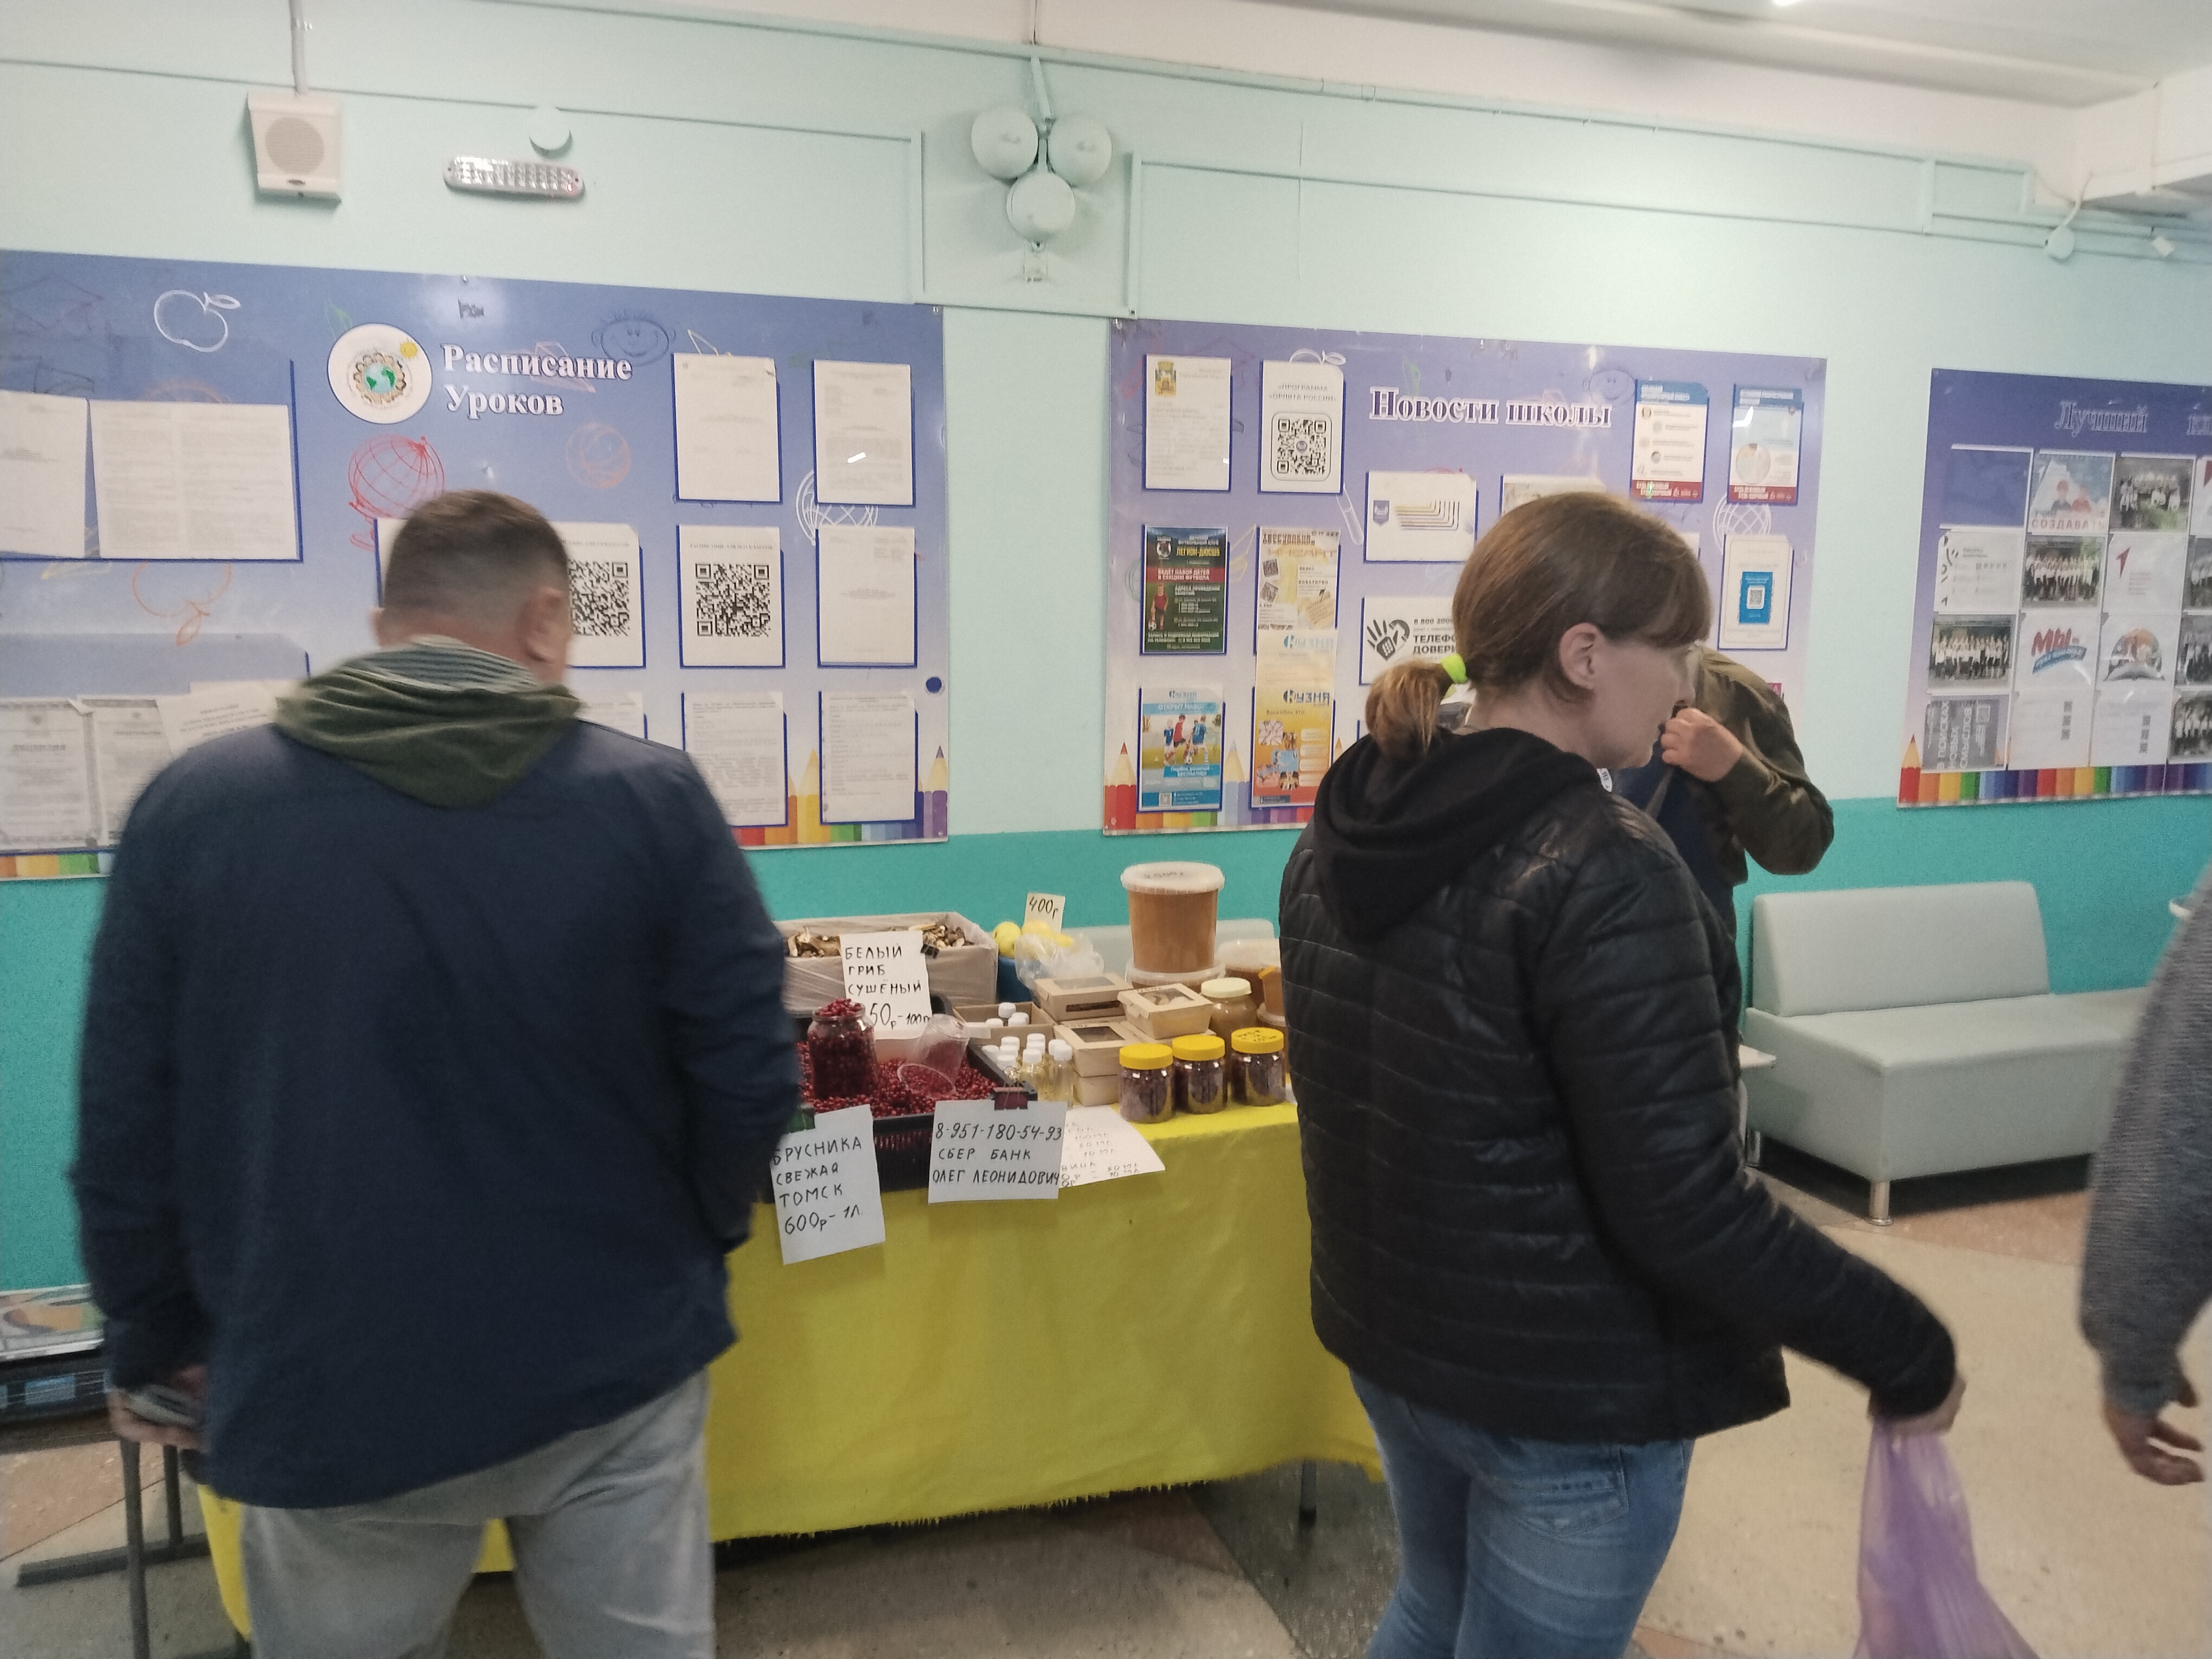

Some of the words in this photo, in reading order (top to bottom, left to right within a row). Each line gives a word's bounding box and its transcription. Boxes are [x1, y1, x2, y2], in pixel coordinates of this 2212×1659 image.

[440, 343, 633, 380] Расписание
[443, 383, 564, 420] Уроков
[1369, 386, 1500, 425] Новости
[1505, 400, 1612, 428] школы
[2054, 401, 2147, 437] Лучший
[2031, 518, 2105, 530] СОЗДАВАТЬ
[2031, 627, 2072, 657] МЫ
[1283, 690, 1330, 706] КУЗНЯ
[1029, 896, 1059, 920] 400р
[845, 943, 902, 960] БЕЛЫЙ
[848, 964, 885, 975] ГРИБ
[848, 979, 922, 996] СУШЁНЫЙ
[935, 1122, 1063, 1141] 8-951-180-54-93
[773, 1136, 862, 1166] БРУСНИКА
[938, 1148, 975, 1160] СБЕР
[991, 1149, 1031, 1161] БАНК
[776, 1162, 839, 1186] СВЕЖАЯ
[933, 1169, 966, 1182] ОЛЕГ
[973, 1170, 1060, 1186] ЛЕОНИДОВИЧ
[780, 1184, 843, 1207] ТОМСК
